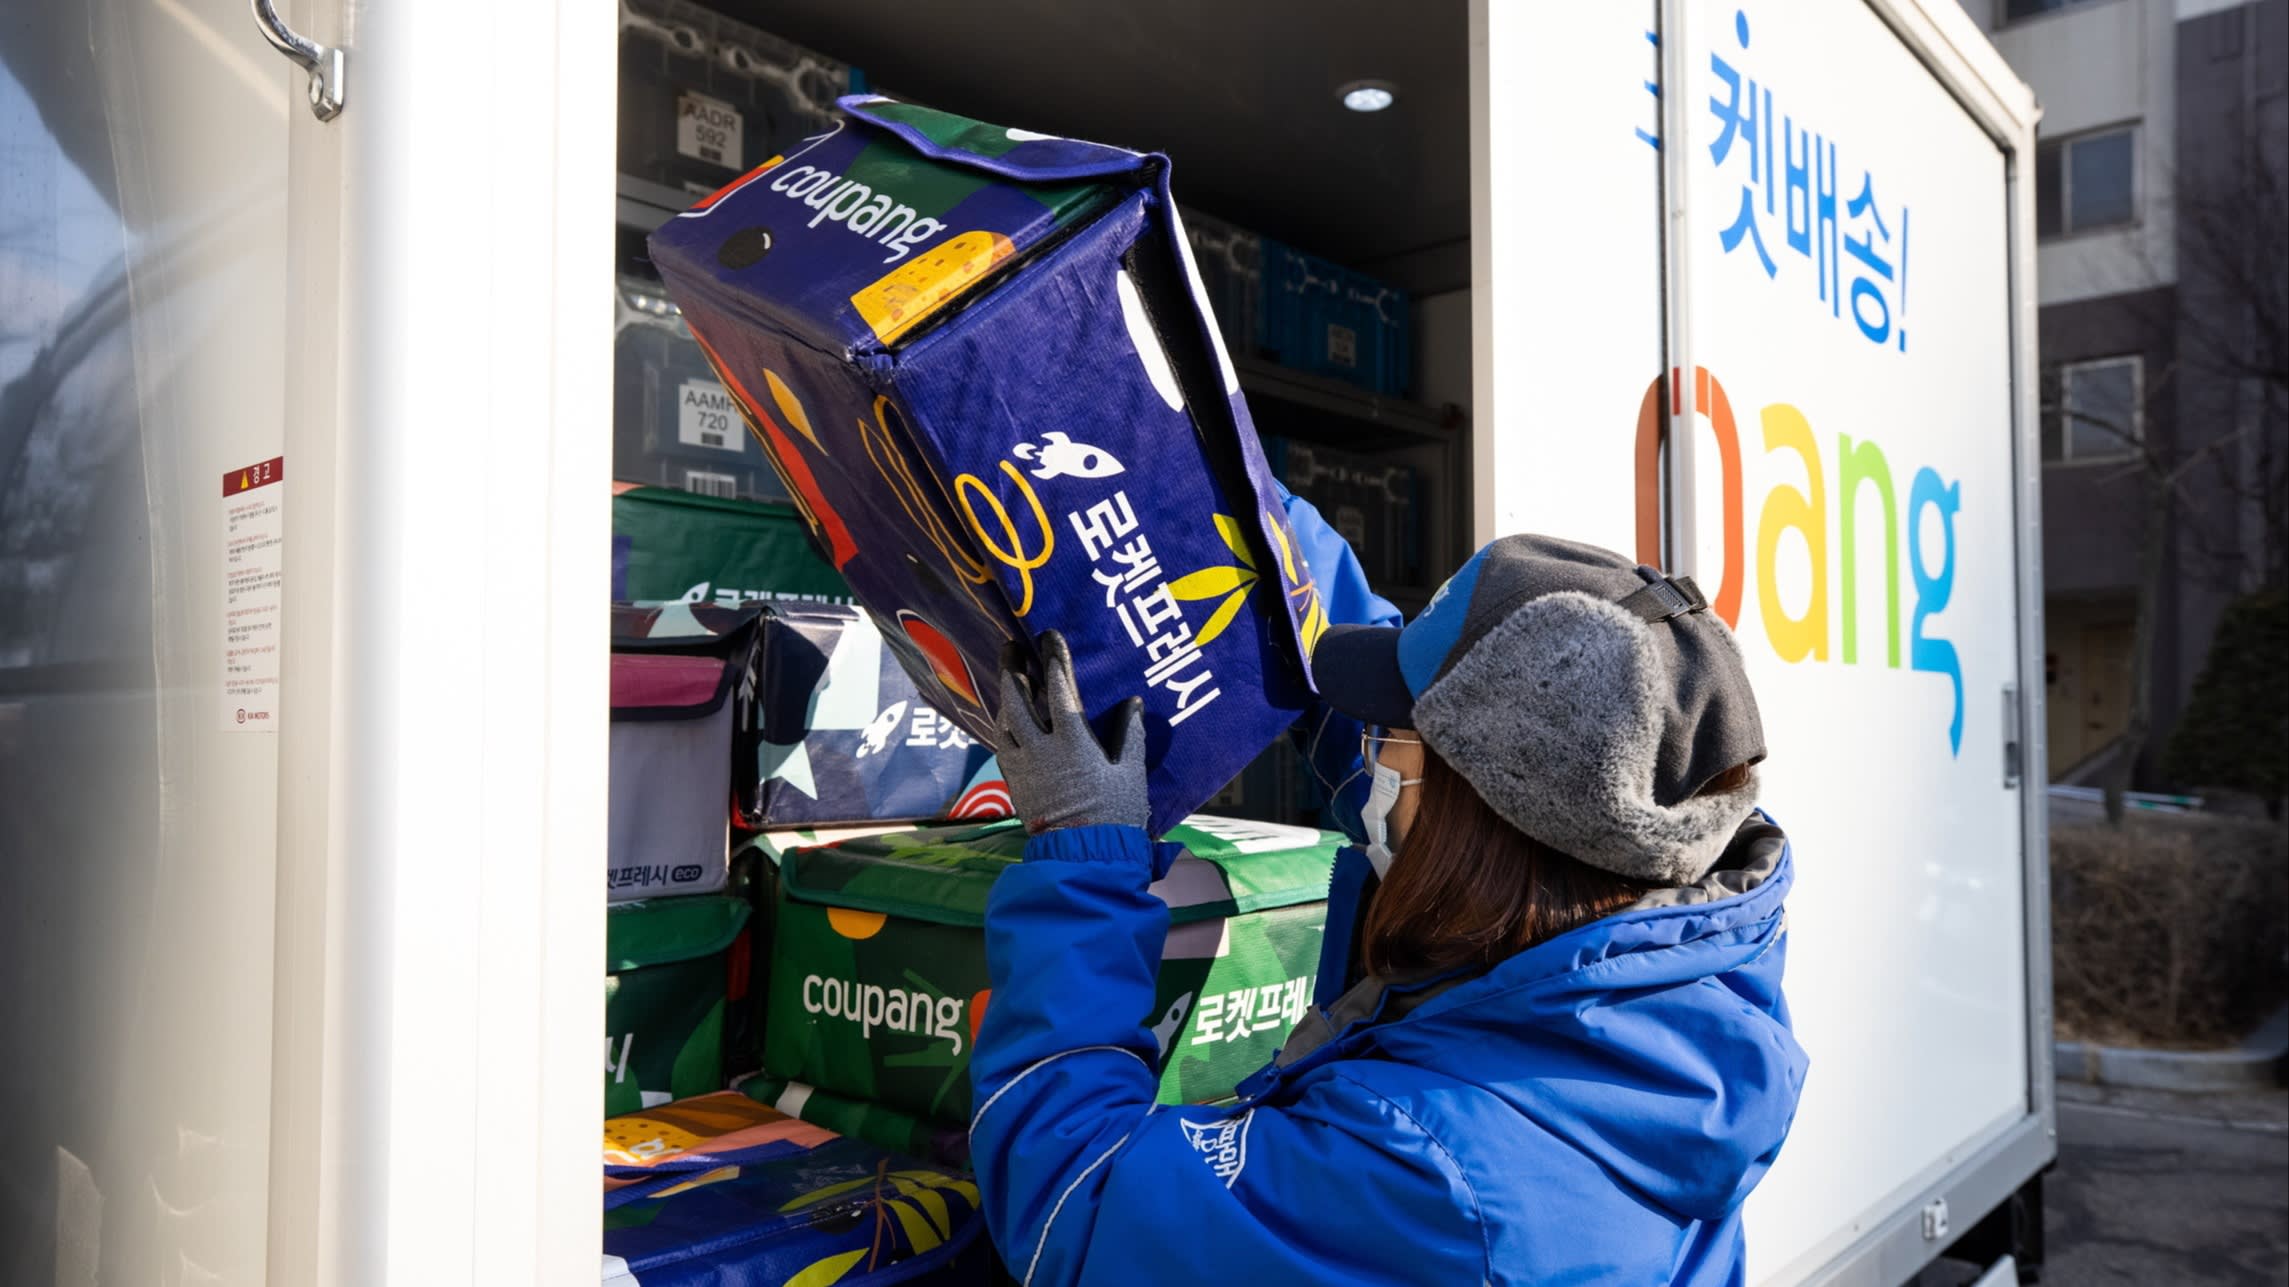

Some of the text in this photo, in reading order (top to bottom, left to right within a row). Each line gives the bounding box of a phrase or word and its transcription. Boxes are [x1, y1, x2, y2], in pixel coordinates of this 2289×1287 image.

[696, 124, 726, 149] 592
[771, 165, 947, 264] coupang
[1635, 9, 1908, 353] 켓배송!
[698, 411, 728, 431] 720
[1068, 490, 1221, 727] 로켓프레시
[674, 868, 699, 880] eco
[803, 974, 963, 1056] coupang
